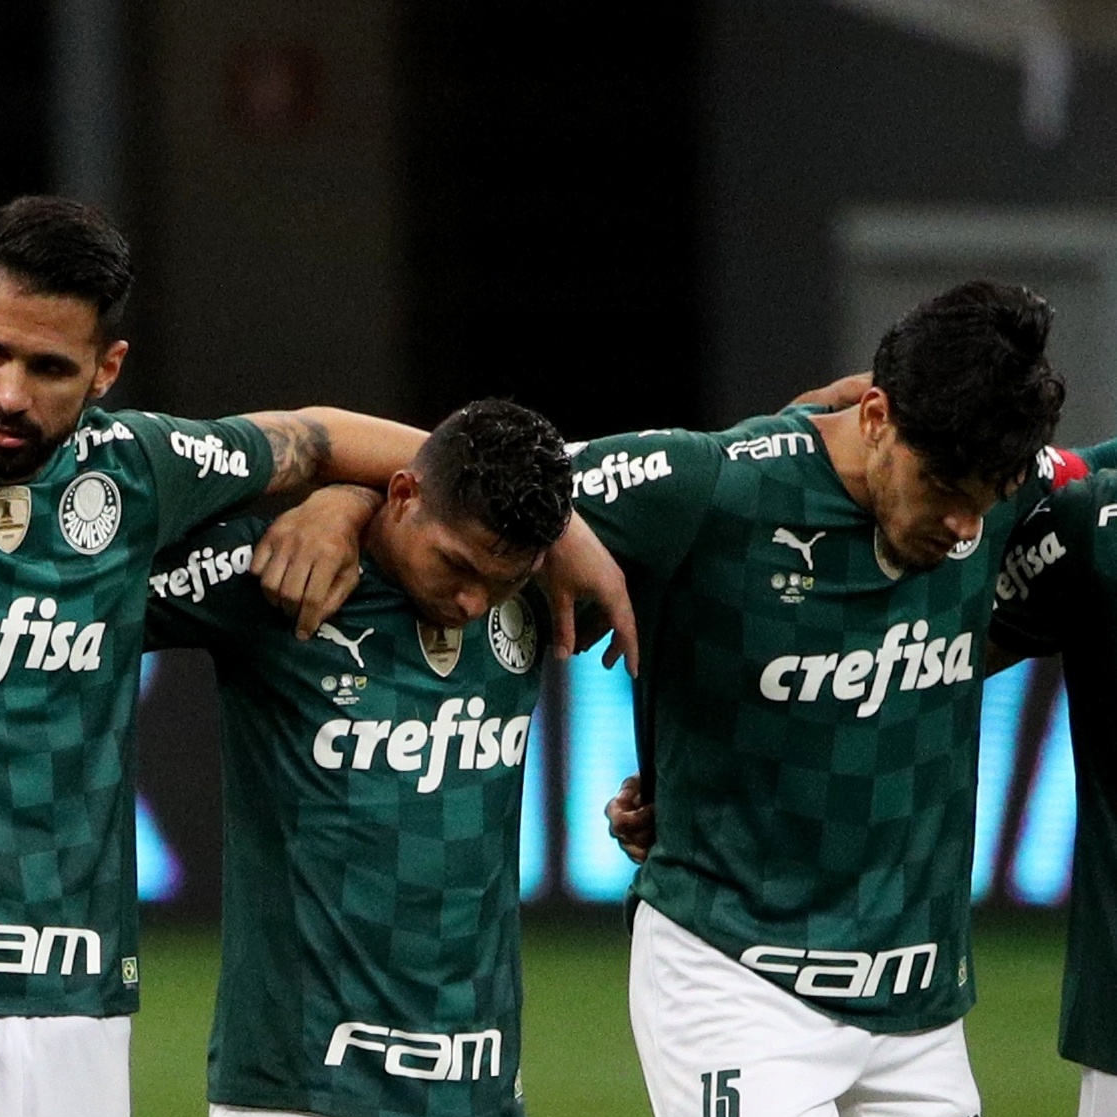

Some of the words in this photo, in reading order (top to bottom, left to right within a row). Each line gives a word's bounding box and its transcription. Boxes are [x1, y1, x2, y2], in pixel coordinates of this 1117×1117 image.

[169, 430, 250, 479] crefisa
[63, 505, 116, 550] PALMEIRAS
[759, 619, 973, 718] crefisa
[312, 696, 531, 794] crefisa
